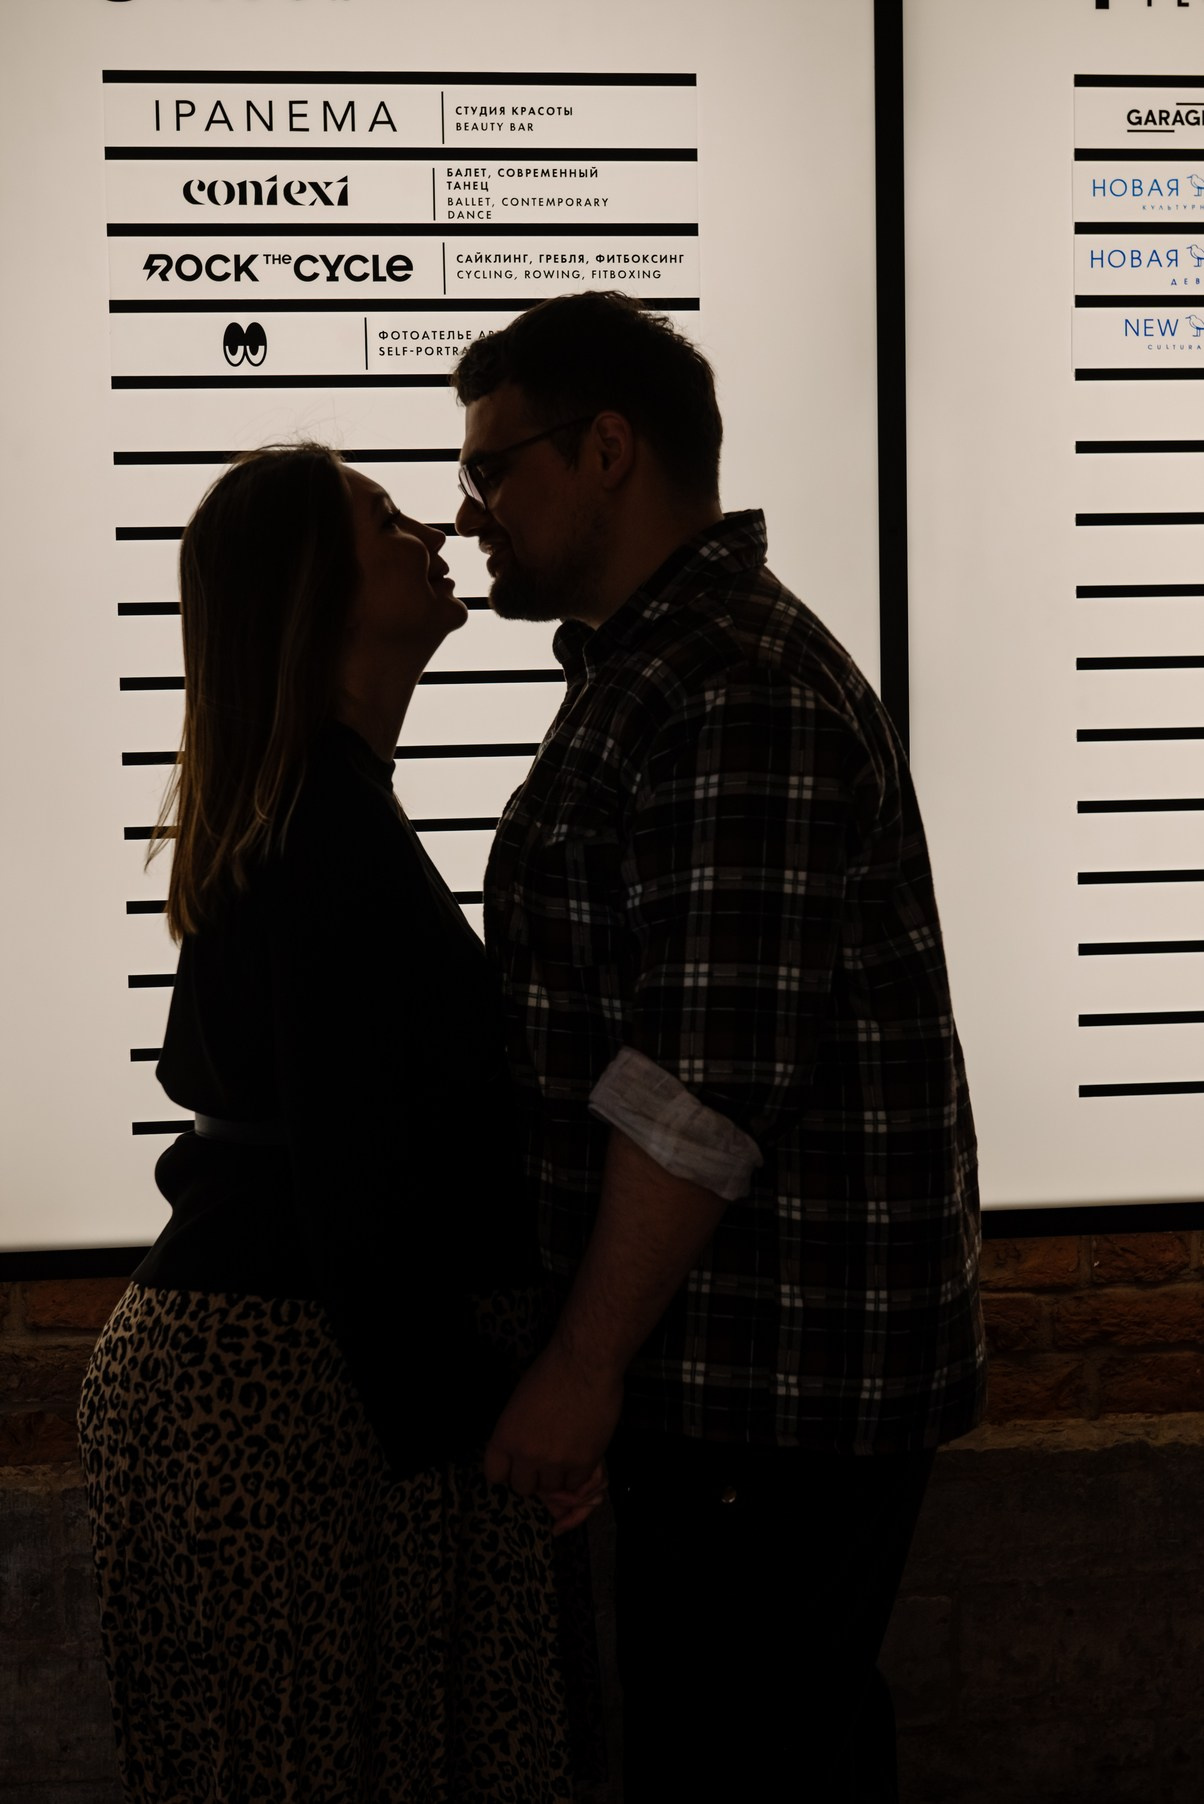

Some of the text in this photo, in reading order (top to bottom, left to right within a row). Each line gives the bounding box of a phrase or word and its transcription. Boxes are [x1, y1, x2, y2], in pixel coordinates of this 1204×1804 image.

[154, 99, 398, 132] IPANEMA
[455, 106, 573, 117] СТУДИЯ КРАСОТЫ
[1126, 108, 1204, 126] GARAG
[455, 122, 534, 132] BEAUTY BAR
[446, 166, 599, 179] БАЛЕТ, СОВРЕМЕННЫЙ
[182, 174, 349, 206] context
[446, 180, 489, 192] ТАНЕЦ
[1092, 178, 1179, 197] НОВАЯ
[447, 197, 609, 208] BALLET, CONTEMPORARY
[447, 210, 492, 220] DANCE
[456, 252, 685, 265] САЙКЛИНГ, ГРЕБЛЯ, ФИТБОКСИНГ
[1090, 249, 1179, 268] НОВАЯ
[142, 253, 260, 282] ROCK
[456, 270, 662, 281] CYCLING, ROWING, FITBOXING
[1124, 318, 1179, 337] NEW
[378, 330, 472, 341] ФОТОАТЕЛЬЕ
